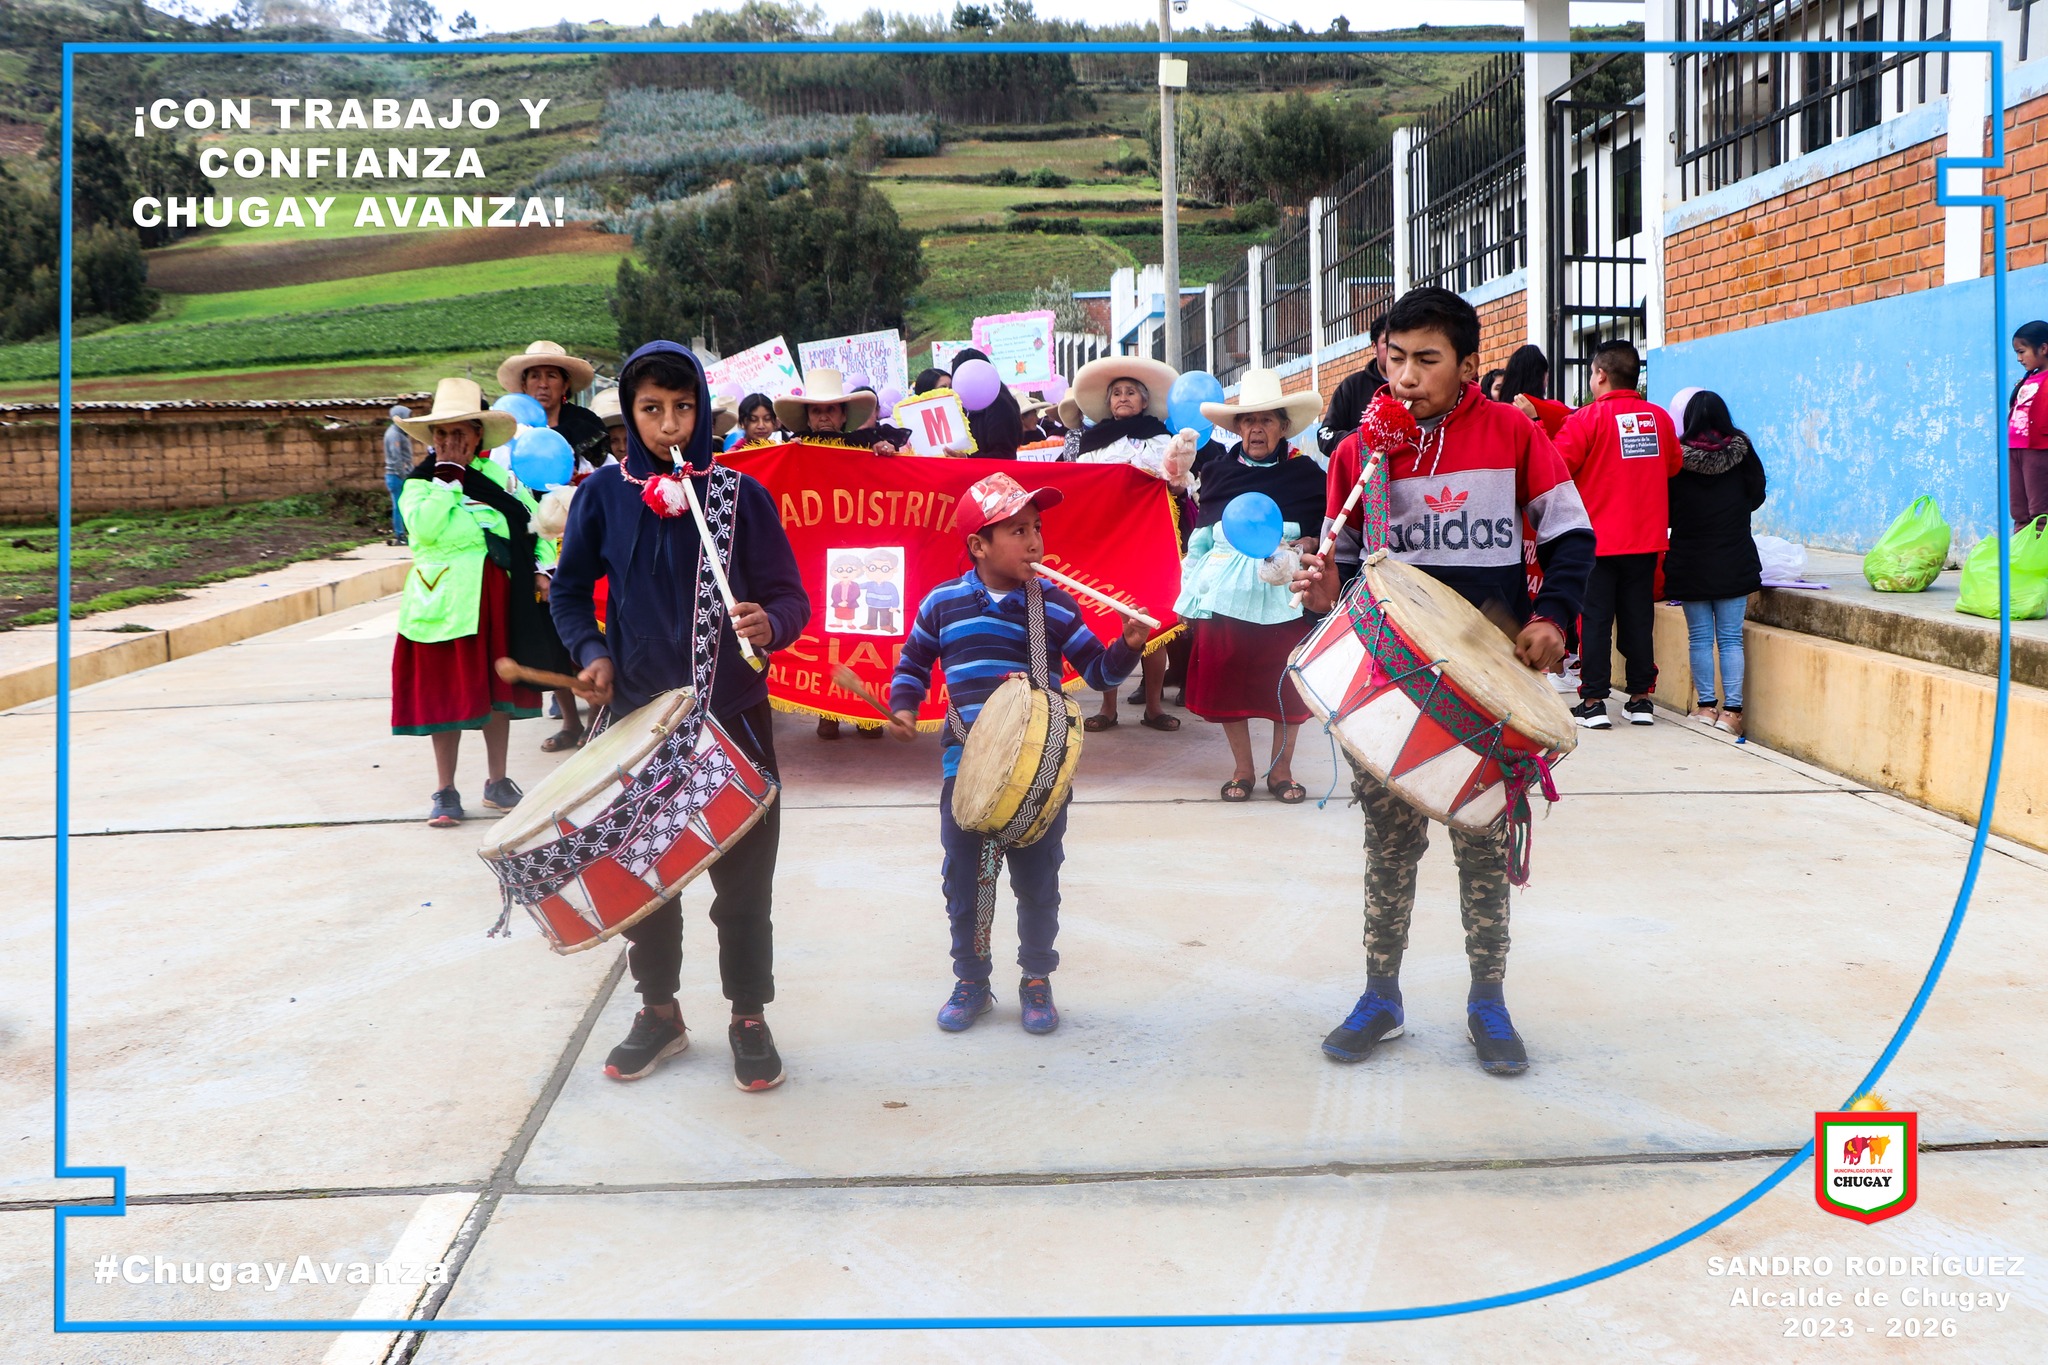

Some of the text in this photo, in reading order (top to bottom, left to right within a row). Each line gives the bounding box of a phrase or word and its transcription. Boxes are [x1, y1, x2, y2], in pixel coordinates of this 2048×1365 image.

[809, 340, 885, 360] HOMBRE QUE TRATA
[870, 347, 892, 359] COMO
[920, 405, 953, 447] M
[1638, 418, 1654, 428] PERÚ
[1388, 511, 1513, 553] adidas
[795, 669, 822, 694] DE
